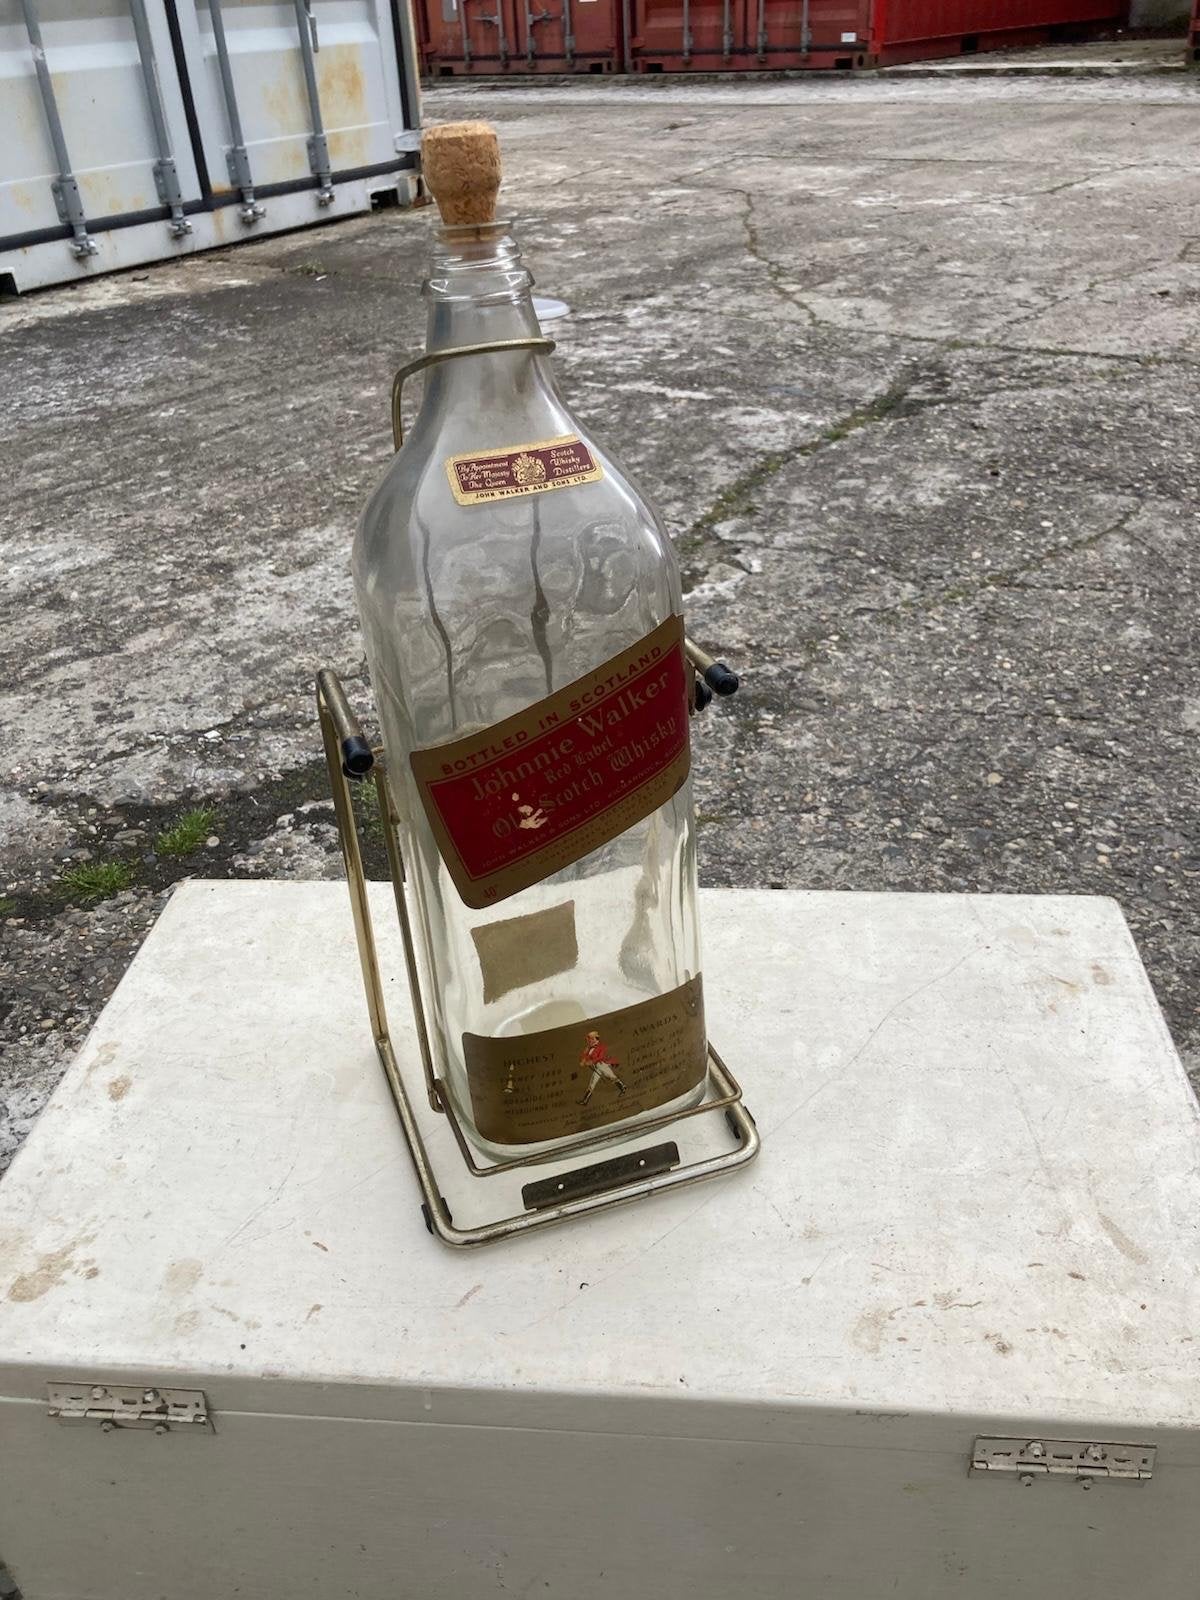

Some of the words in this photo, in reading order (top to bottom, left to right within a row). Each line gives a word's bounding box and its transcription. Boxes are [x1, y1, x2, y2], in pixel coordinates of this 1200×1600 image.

[550, 448, 575, 459] Scotch
[550, 457, 581, 466] Whisky
[552, 464, 591, 476] Distillers
[500, 486, 530, 496] WALKER
[551, 479, 570, 487] SONS
[440, 730, 528, 775] BOTTLED
[538, 711, 560, 730] IN
[569, 646, 663, 712] SCOTLAND
[472, 738, 576, 801] Johnnie
[577, 672, 670, 737] Walker
[539, 769, 604, 811] Scotch
[607, 717, 677, 772] Whisky
[544, 763, 572, 785] Red
[575, 735, 614, 768] Label
